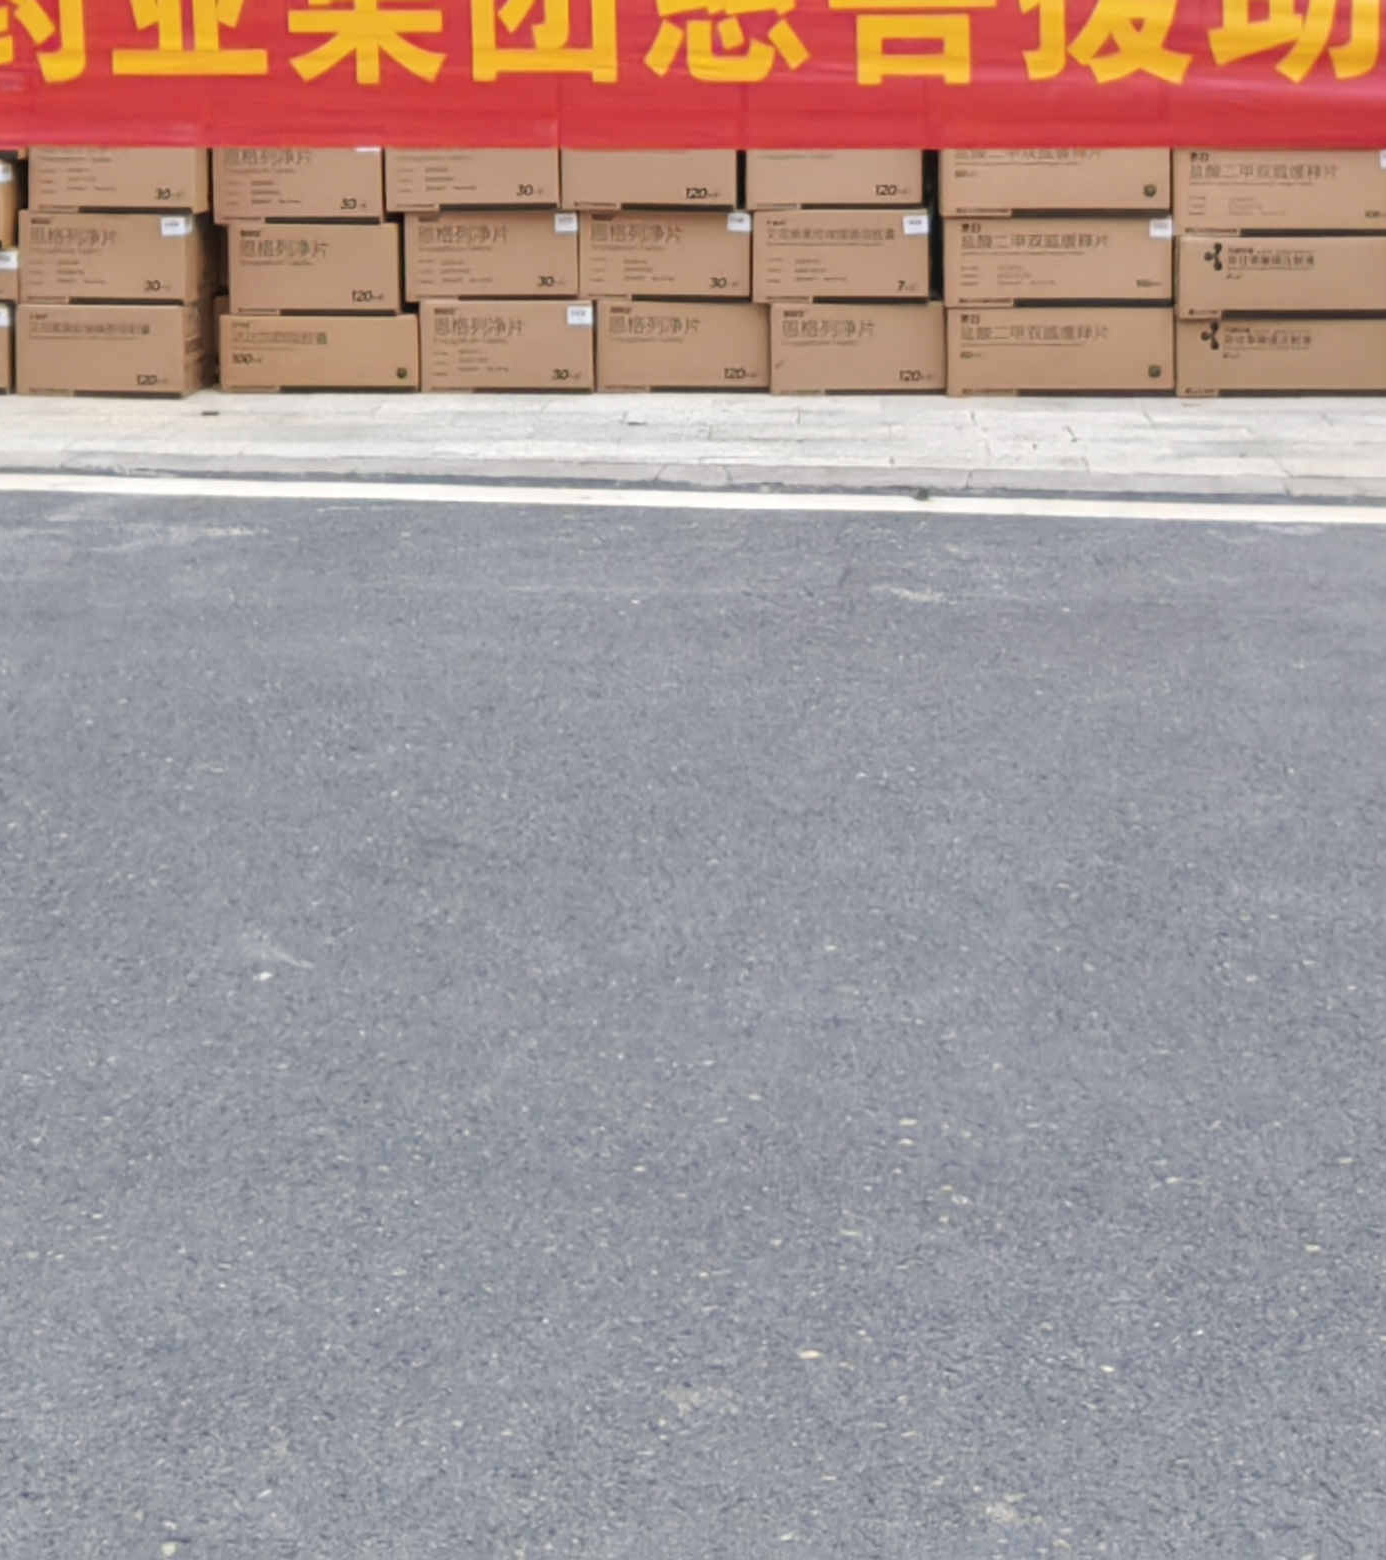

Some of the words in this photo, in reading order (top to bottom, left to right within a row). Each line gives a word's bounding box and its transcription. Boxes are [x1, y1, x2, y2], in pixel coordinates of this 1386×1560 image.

[517, 184, 534, 196] 30
[686, 187, 708, 199] 120
[875, 184, 897, 196] 120
[145, 280, 161, 291] 30
[352, 290, 373, 302] 120
[724, 367, 746, 379] 120
[136, 374, 158, 386] 120
